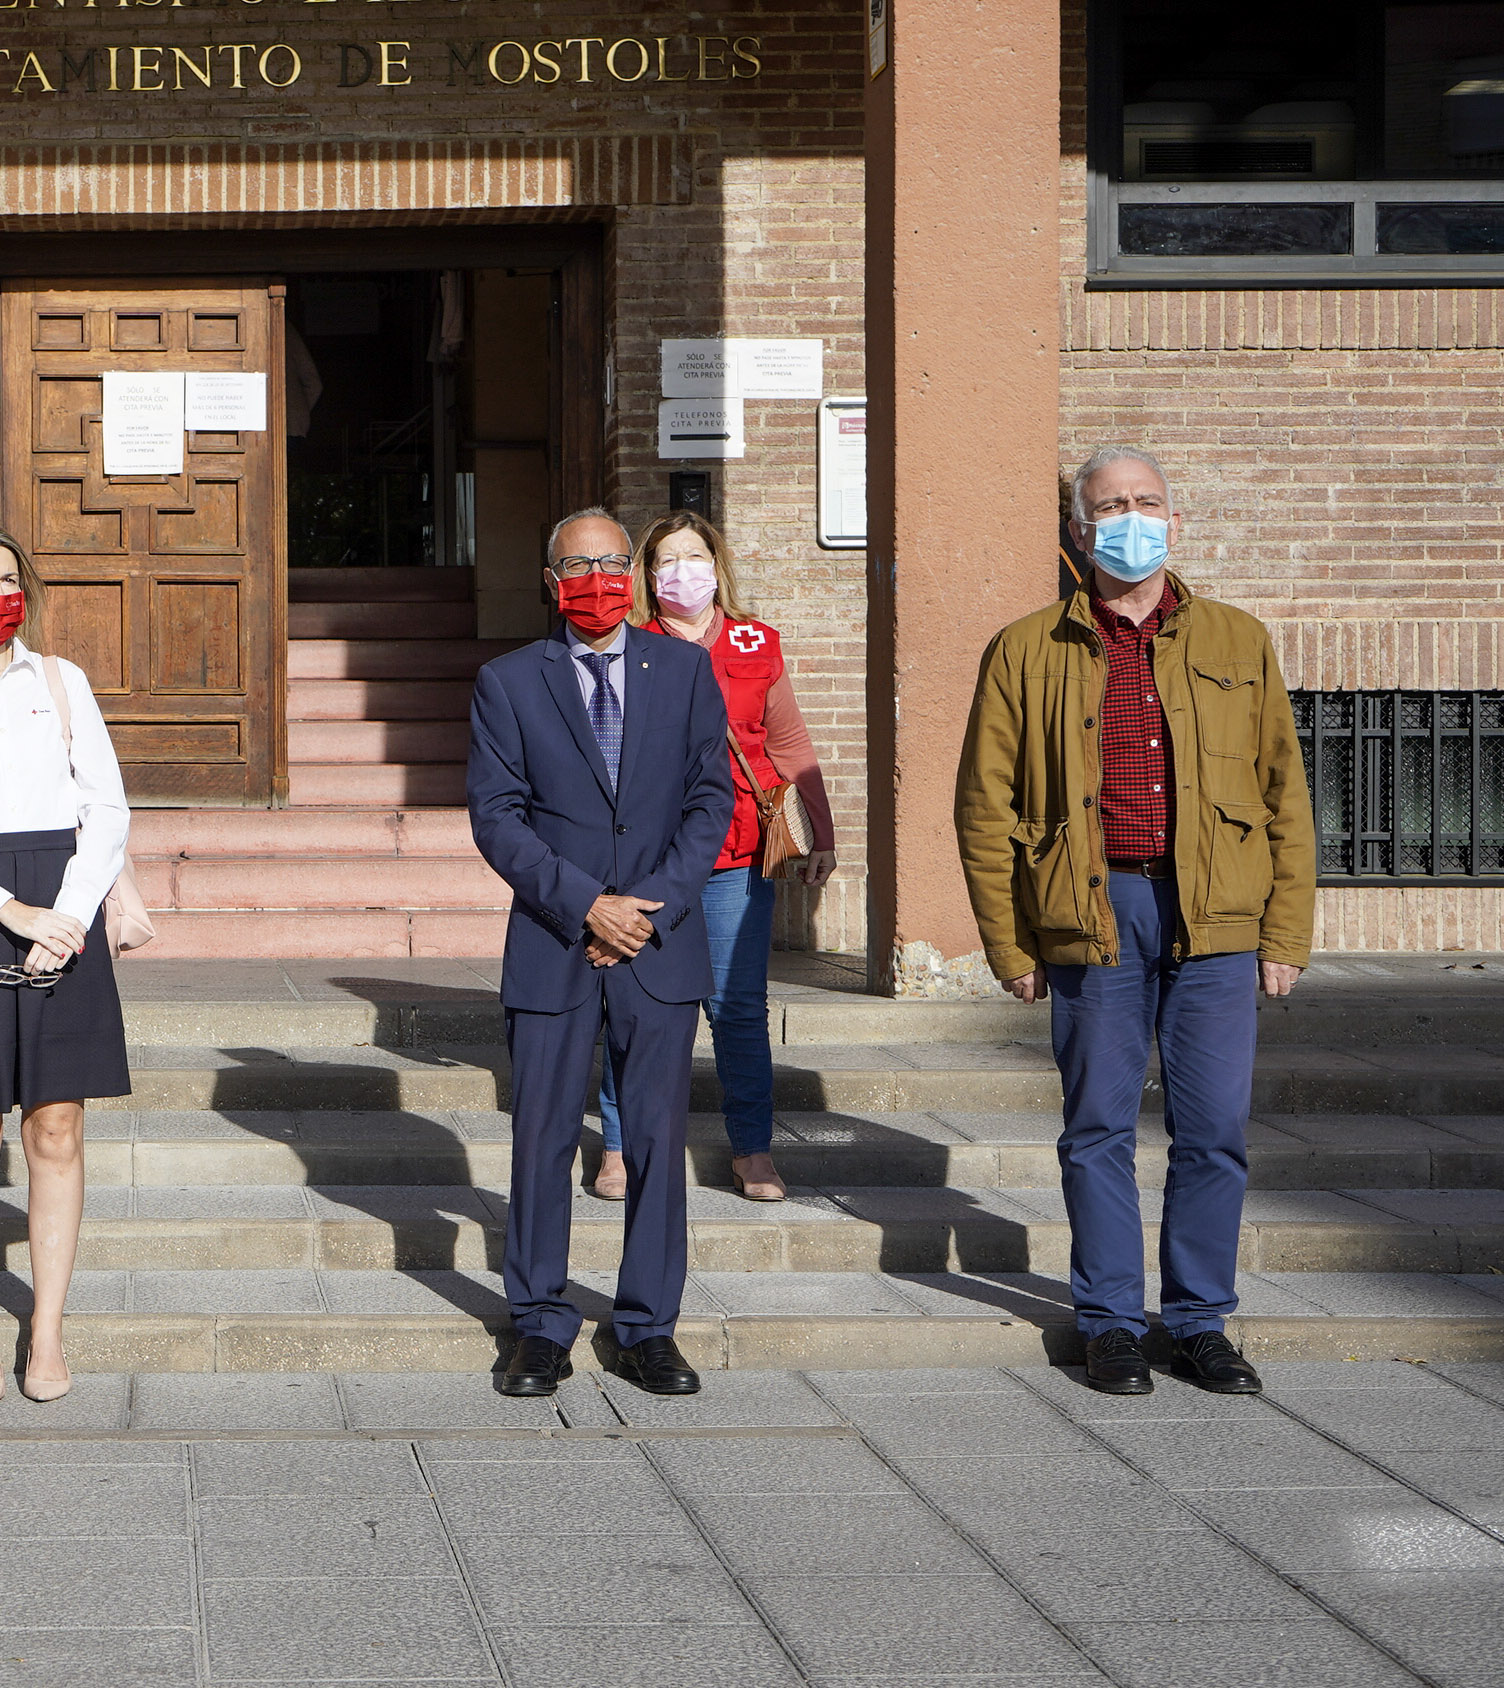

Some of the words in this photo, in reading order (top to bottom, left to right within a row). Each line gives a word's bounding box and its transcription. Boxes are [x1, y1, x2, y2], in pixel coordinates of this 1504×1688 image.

[336, 41, 413, 88] DE
[446, 35, 763, 87] MOSTOLES
[686, 352, 705, 361] SÓLO
[713, 353, 724, 361] SE
[677, 361, 714, 370] ATENDERÁ
[715, 362, 731, 370] CON
[683, 371, 699, 379] CITA
[700, 371, 725, 379] PREVIA
[674, 411, 728, 419] TELEFONOS
[670, 420, 692, 428] CITA
